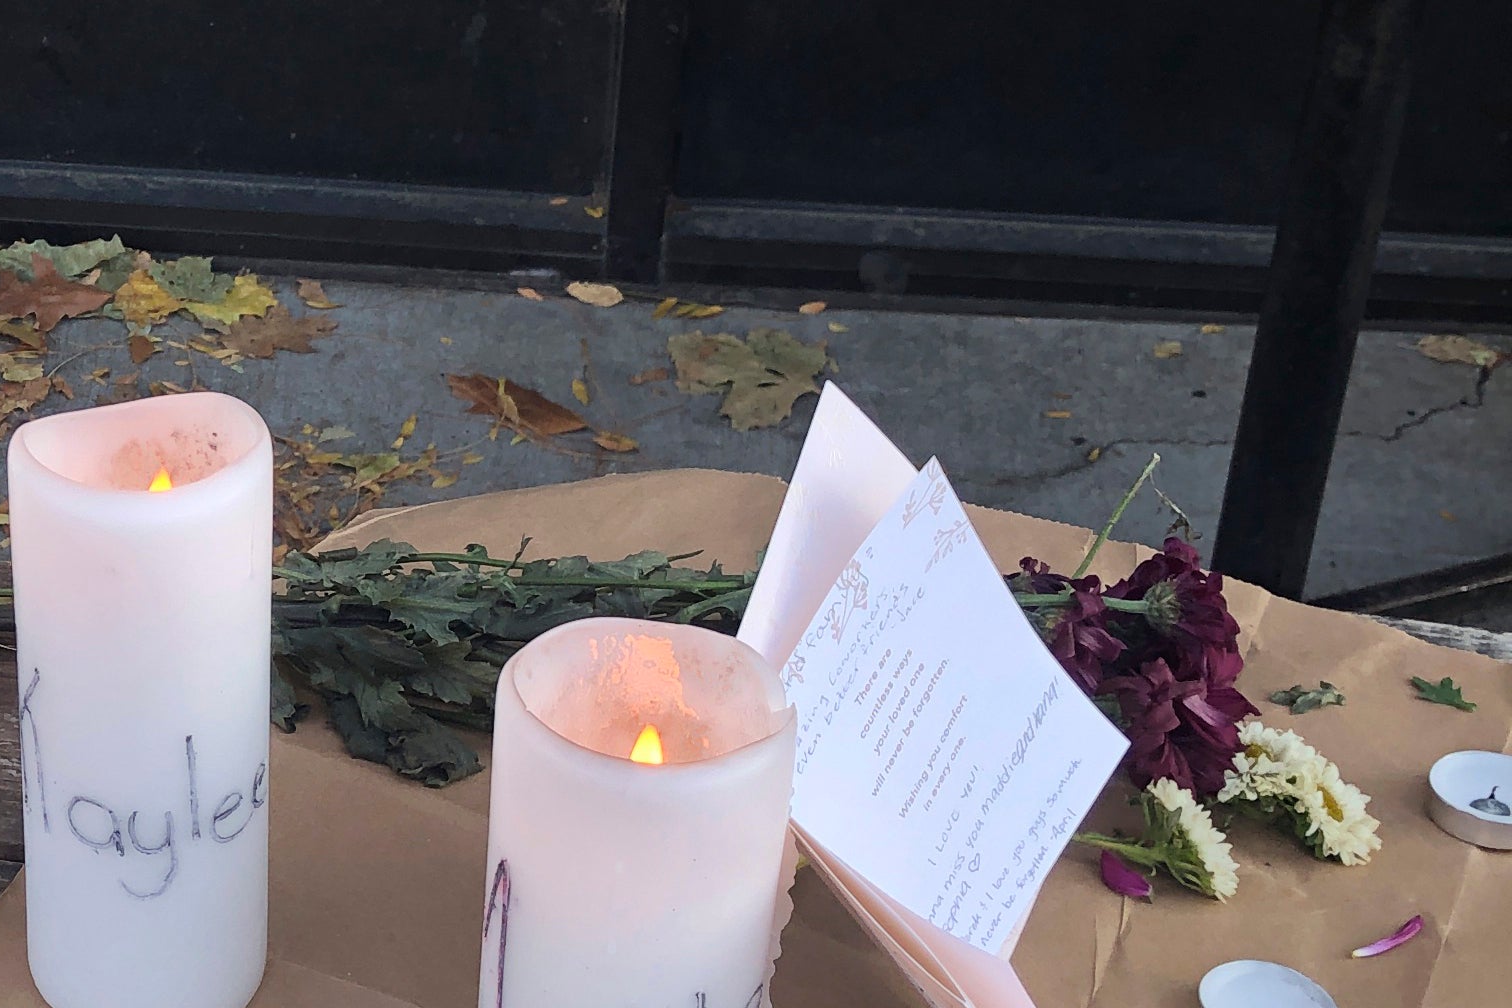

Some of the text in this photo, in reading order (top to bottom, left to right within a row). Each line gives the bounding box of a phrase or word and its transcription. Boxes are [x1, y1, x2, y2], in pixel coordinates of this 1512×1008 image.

[854, 648, 892, 706] There are
[860, 649, 912, 739] countless ways
[873, 663, 925, 757] your loved one
[871, 658, 950, 797] will never be forgotten.
[898, 695, 968, 818] Wishing you comfort
[923, 736, 967, 812] in every one.
